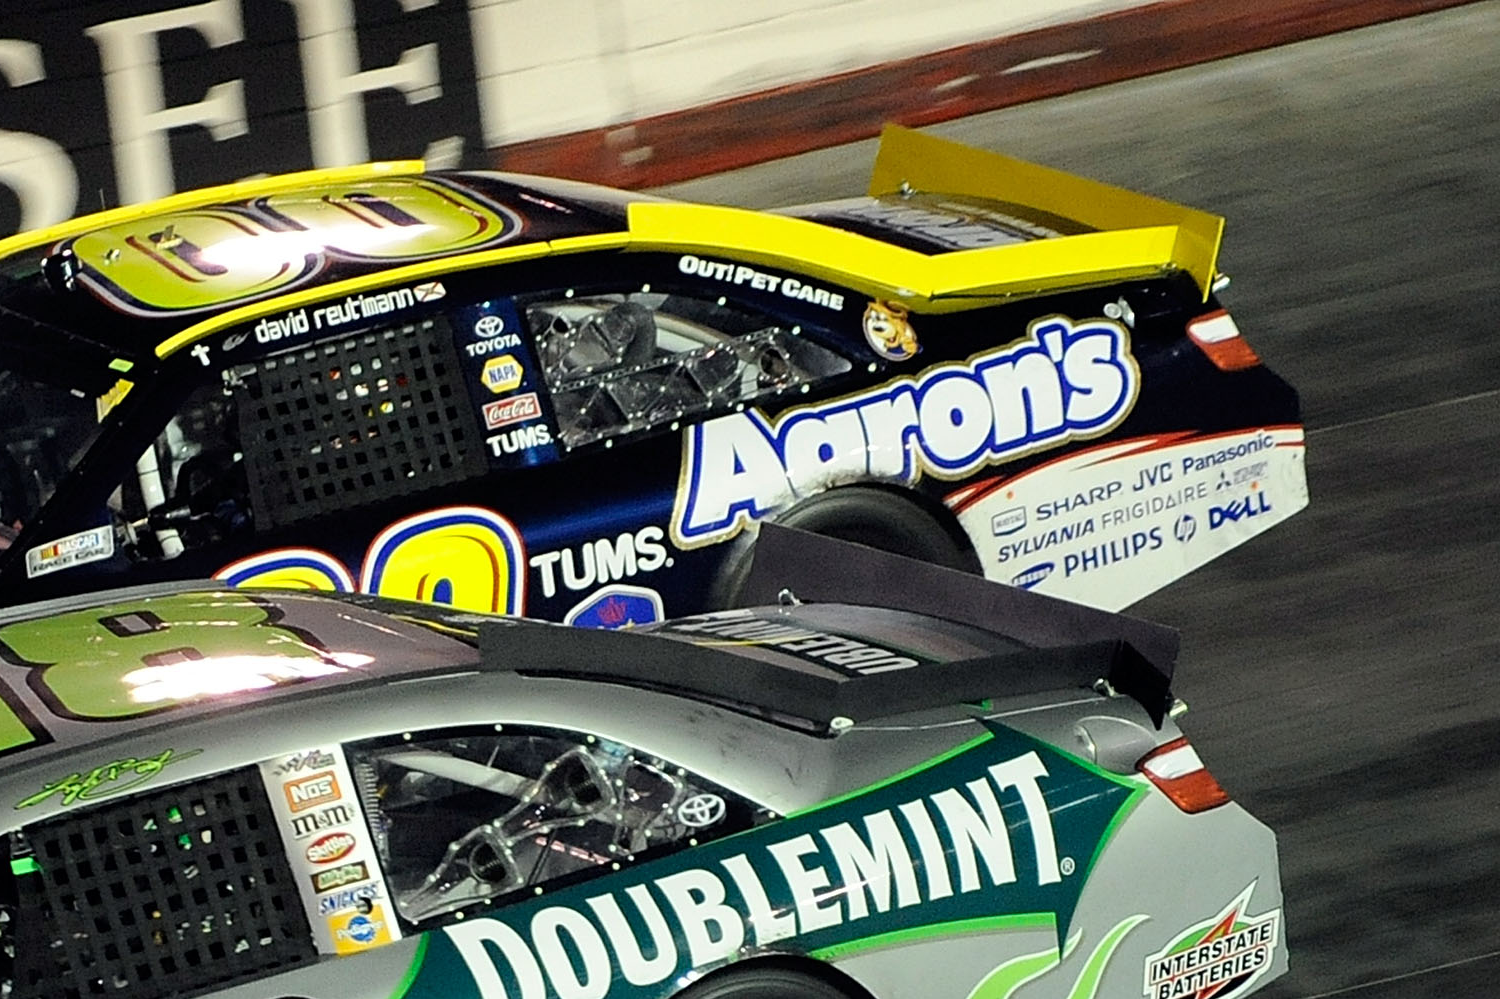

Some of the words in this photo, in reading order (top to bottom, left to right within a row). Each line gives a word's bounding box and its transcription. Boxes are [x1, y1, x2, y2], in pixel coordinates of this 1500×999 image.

[254, 309, 309, 344] david
[313, 287, 415, 330] reutimann
[735, 266, 783, 292] PET
[782, 277, 845, 311] CARE
[466, 333, 522, 357] TOYOTA
[488, 364, 518, 384] NAPA
[675, 320, 1134, 545] Aaron's
[1035, 480, 1122, 521] SHARP
[1132, 462, 1173, 492] JVC
[1182, 433, 1275, 476] Panasonic
[997, 518, 1095, 563] SYLVANIA
[1101, 485, 1208, 530] FRIGIDAIRE
[1063, 526, 1164, 577] PHILIPS
[1208, 490, 1272, 530] DELL
[32, 555, 73, 573] RACE
[75, 547, 104, 561] CAR
[289, 776, 334, 803] NOS
[1152, 922, 1272, 981] INTERSTATE
